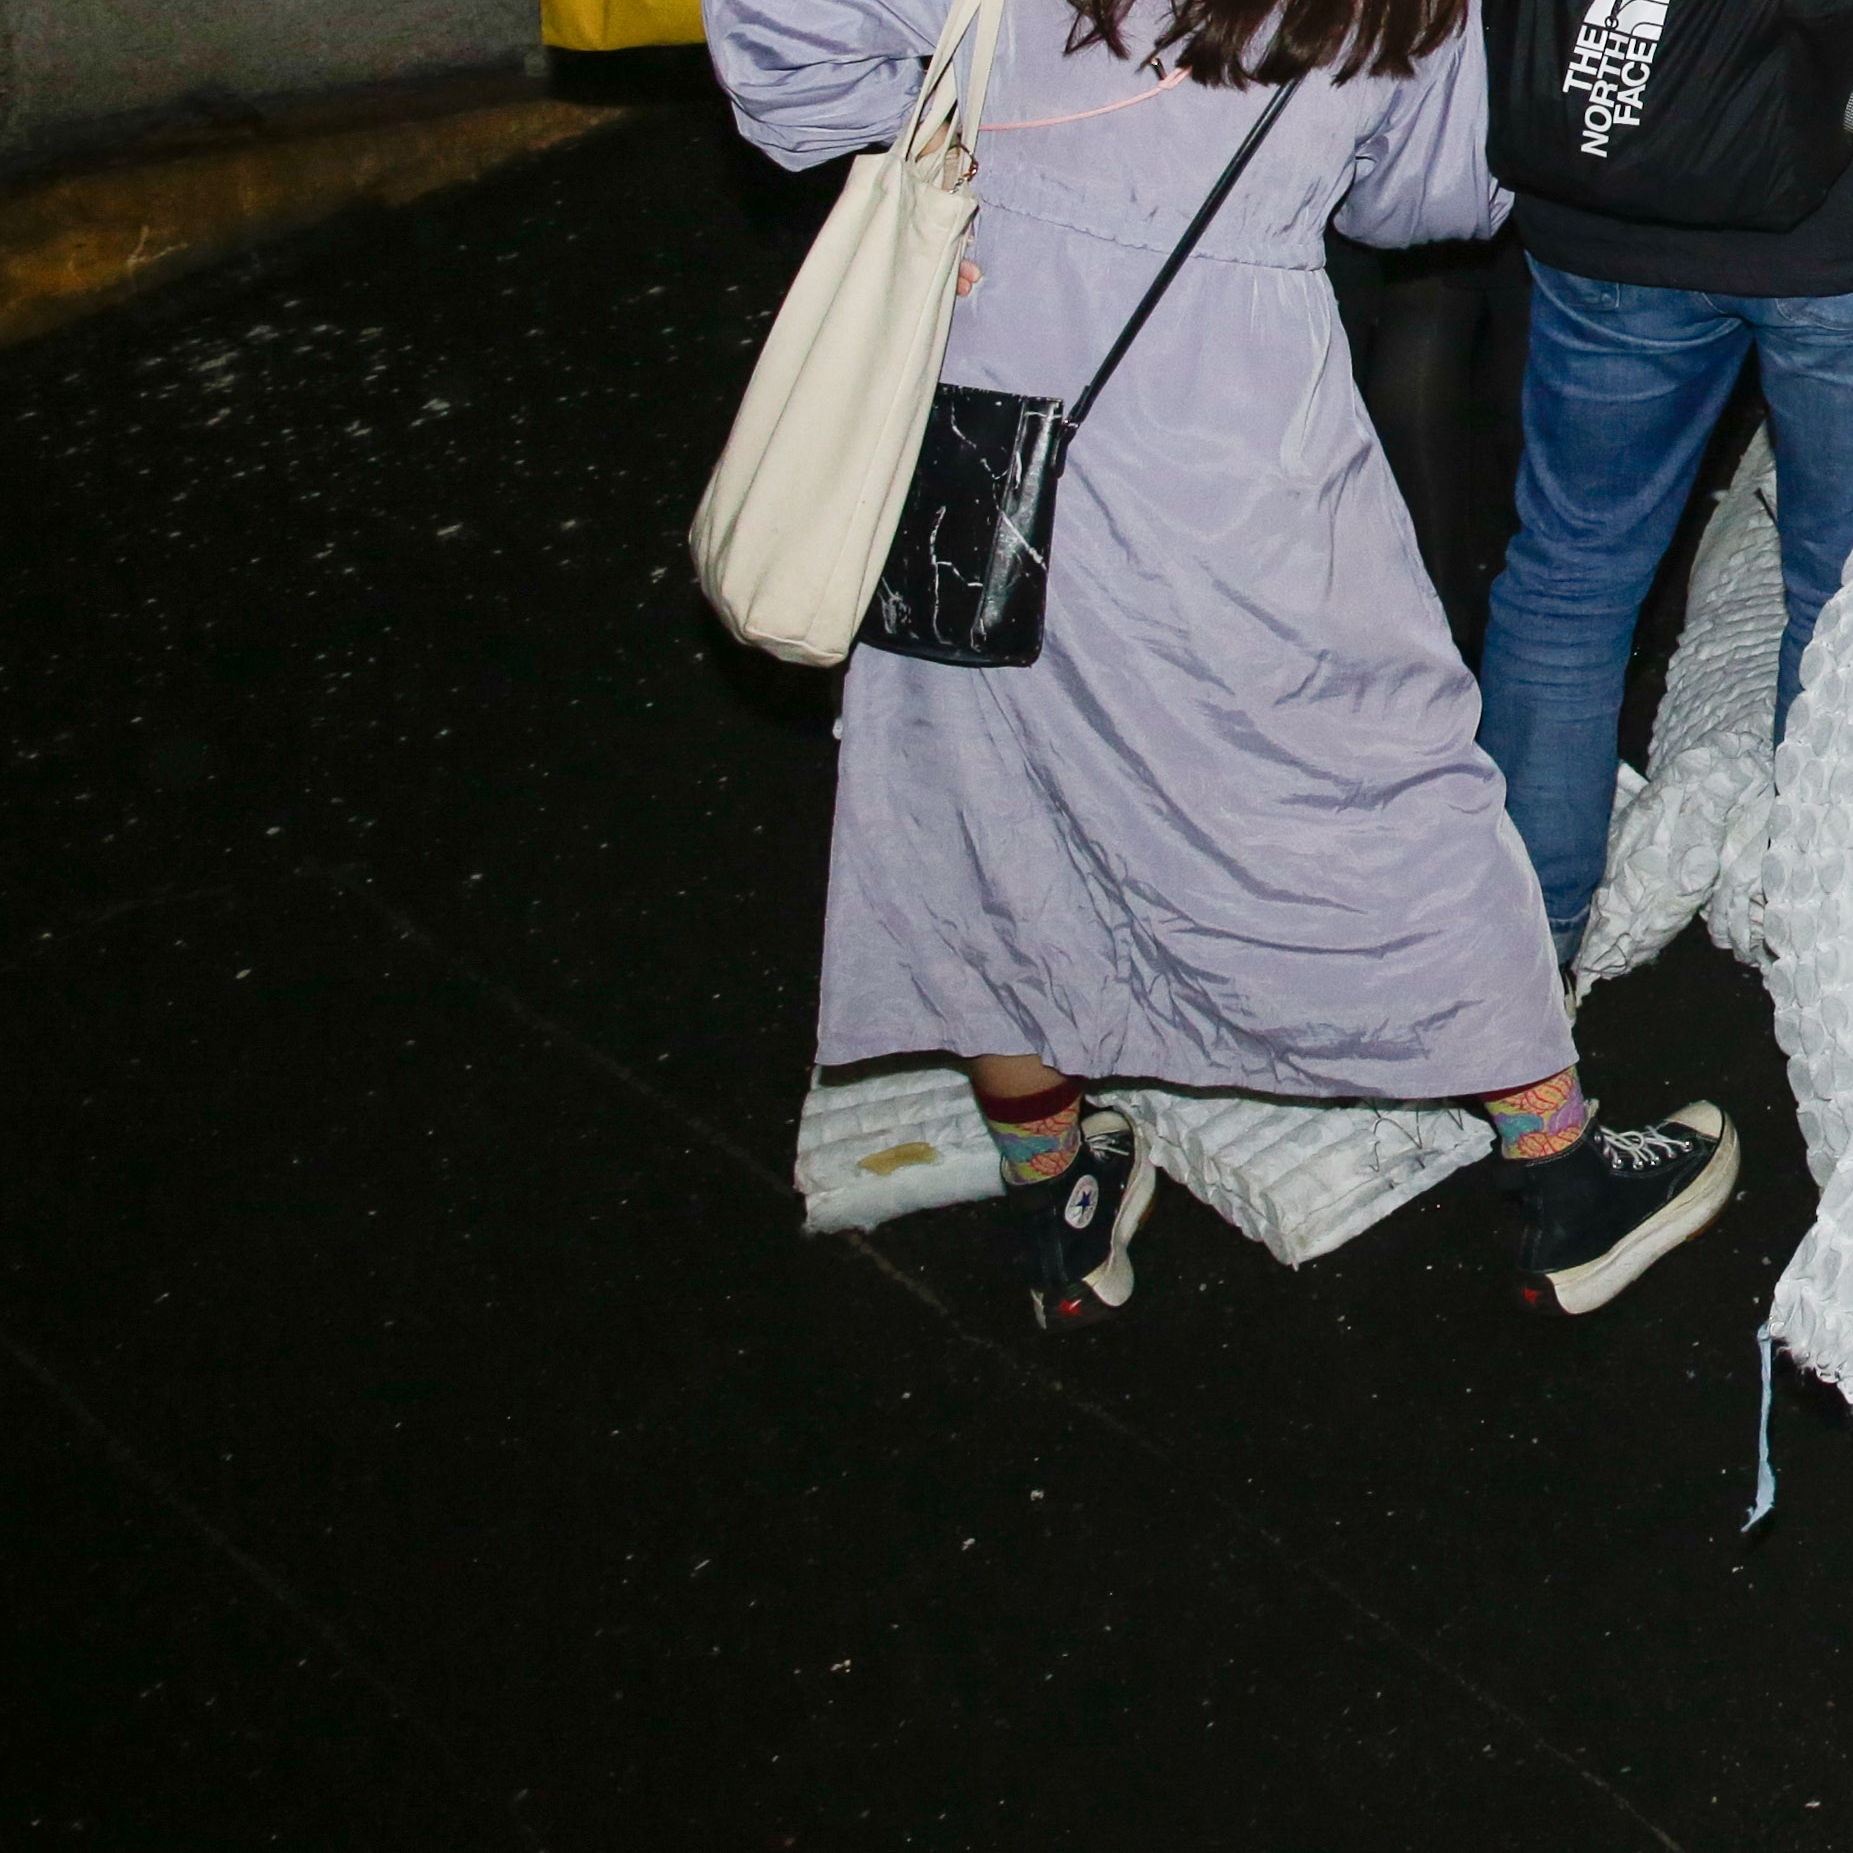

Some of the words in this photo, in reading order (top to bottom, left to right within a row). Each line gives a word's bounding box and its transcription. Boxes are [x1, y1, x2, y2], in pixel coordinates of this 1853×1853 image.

[1562, 24, 1608, 93] THE
[1581, 31, 1630, 158] NORTH
[1613, 38, 1658, 126] FACE
